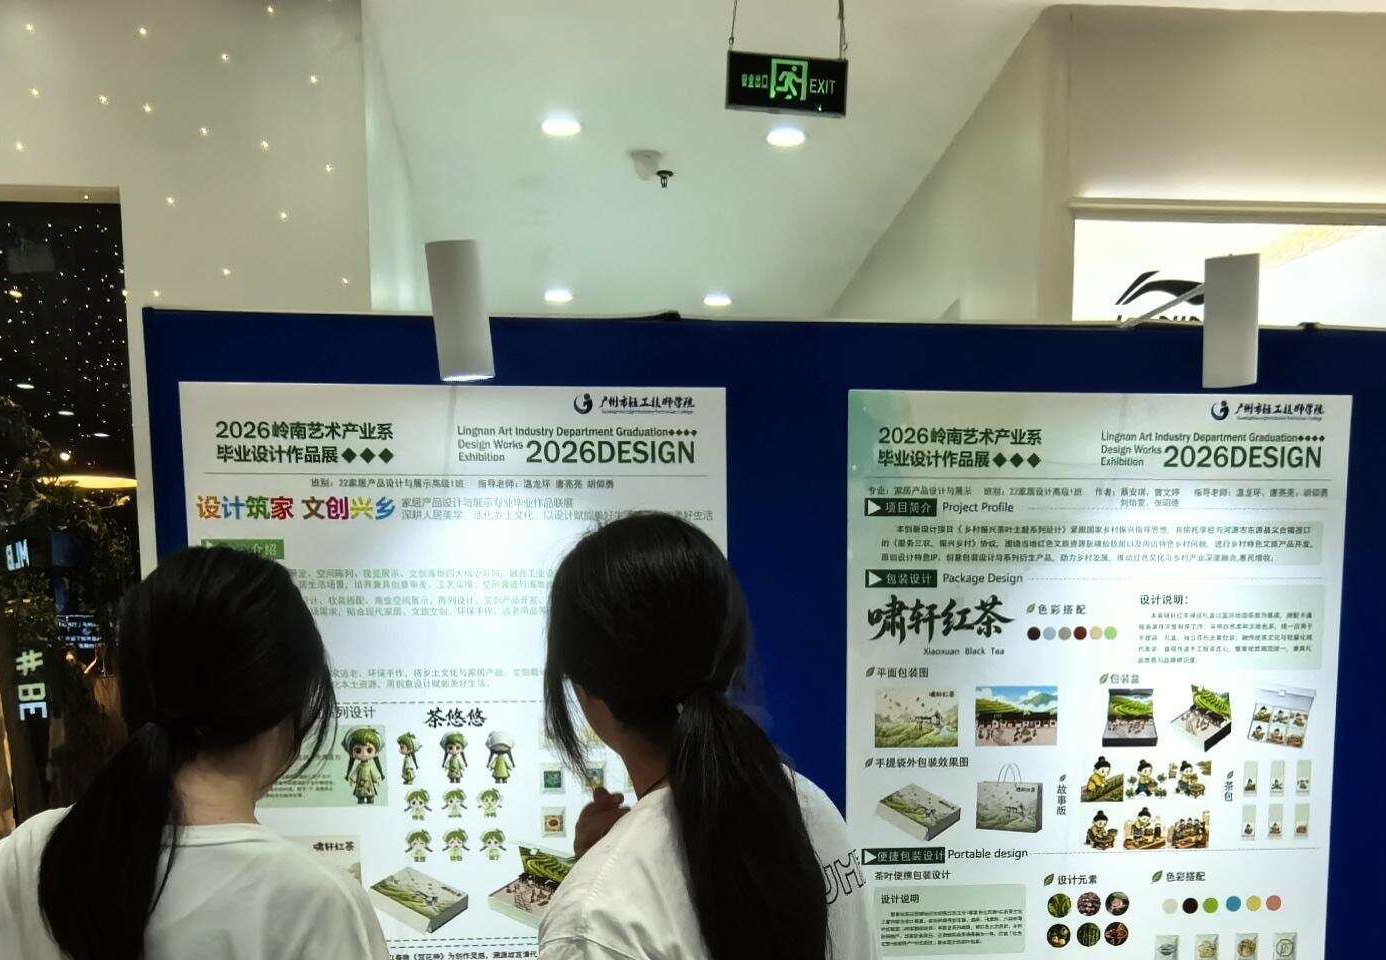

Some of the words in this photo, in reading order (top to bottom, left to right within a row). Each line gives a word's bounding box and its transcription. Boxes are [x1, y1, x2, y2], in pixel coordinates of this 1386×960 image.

[810, 79, 835, 94] EXIT
[215, 420, 394, 441] 2026岭南艺术产业系
[458, 426, 495, 438] Lingnan
[498, 426, 512, 437] Art
[515, 426, 554, 438] Industry
[556, 426, 613, 438] Department
[616, 426, 668, 437] Graduation
[878, 427, 1042, 446] 2026岭南艺术产业系
[1101, 432, 1137, 444] Lingnan
[1139, 432, 1153, 443] Art
[1155, 432, 1192, 444] Industry
[1194, 432, 1247, 444] Department
[1249, 432, 1298, 443] Graduation
[458, 440, 490, 451] Design
[493, 440, 523, 450] Works
[1101, 445, 1131, 456] Design
[1133, 445, 1162, 455] Works
[217, 445, 338, 464] 毕业设计作品展
[459, 452, 505, 462] Exhibition
[526, 440, 696, 465] 2026DESIGN
[1164, 446, 1321, 468] 2026DESIGN
[878, 450, 990, 468] 毕业设计作品展
[1101, 457, 1144, 467] Exhibition
[197, 495, 293, 521] 设计筑家
[302, 495, 395, 521] 文创兴乡
[943, 503, 978, 513] Project
[981, 502, 1014, 512] Profile
[943, 573, 986, 585] Package
[989, 573, 1023, 585] Design
[867, 595, 1014, 643] 啸轩红茶
[924, 647, 961, 656] Xiaoxuan
[964, 647, 988, 656] Black
[991, 647, 1005, 655] Tea
[877, 667, 929, 679] 平面包装图
[425, 707, 487, 728] 茶悠悠
[875, 757, 969, 768] 手提袋外包装效果图
[948, 848, 992, 860] Portable
[994, 848, 1028, 860] design
[1057, 874, 1098, 886] 设计元素
[881, 894, 920, 904] 设计说明
